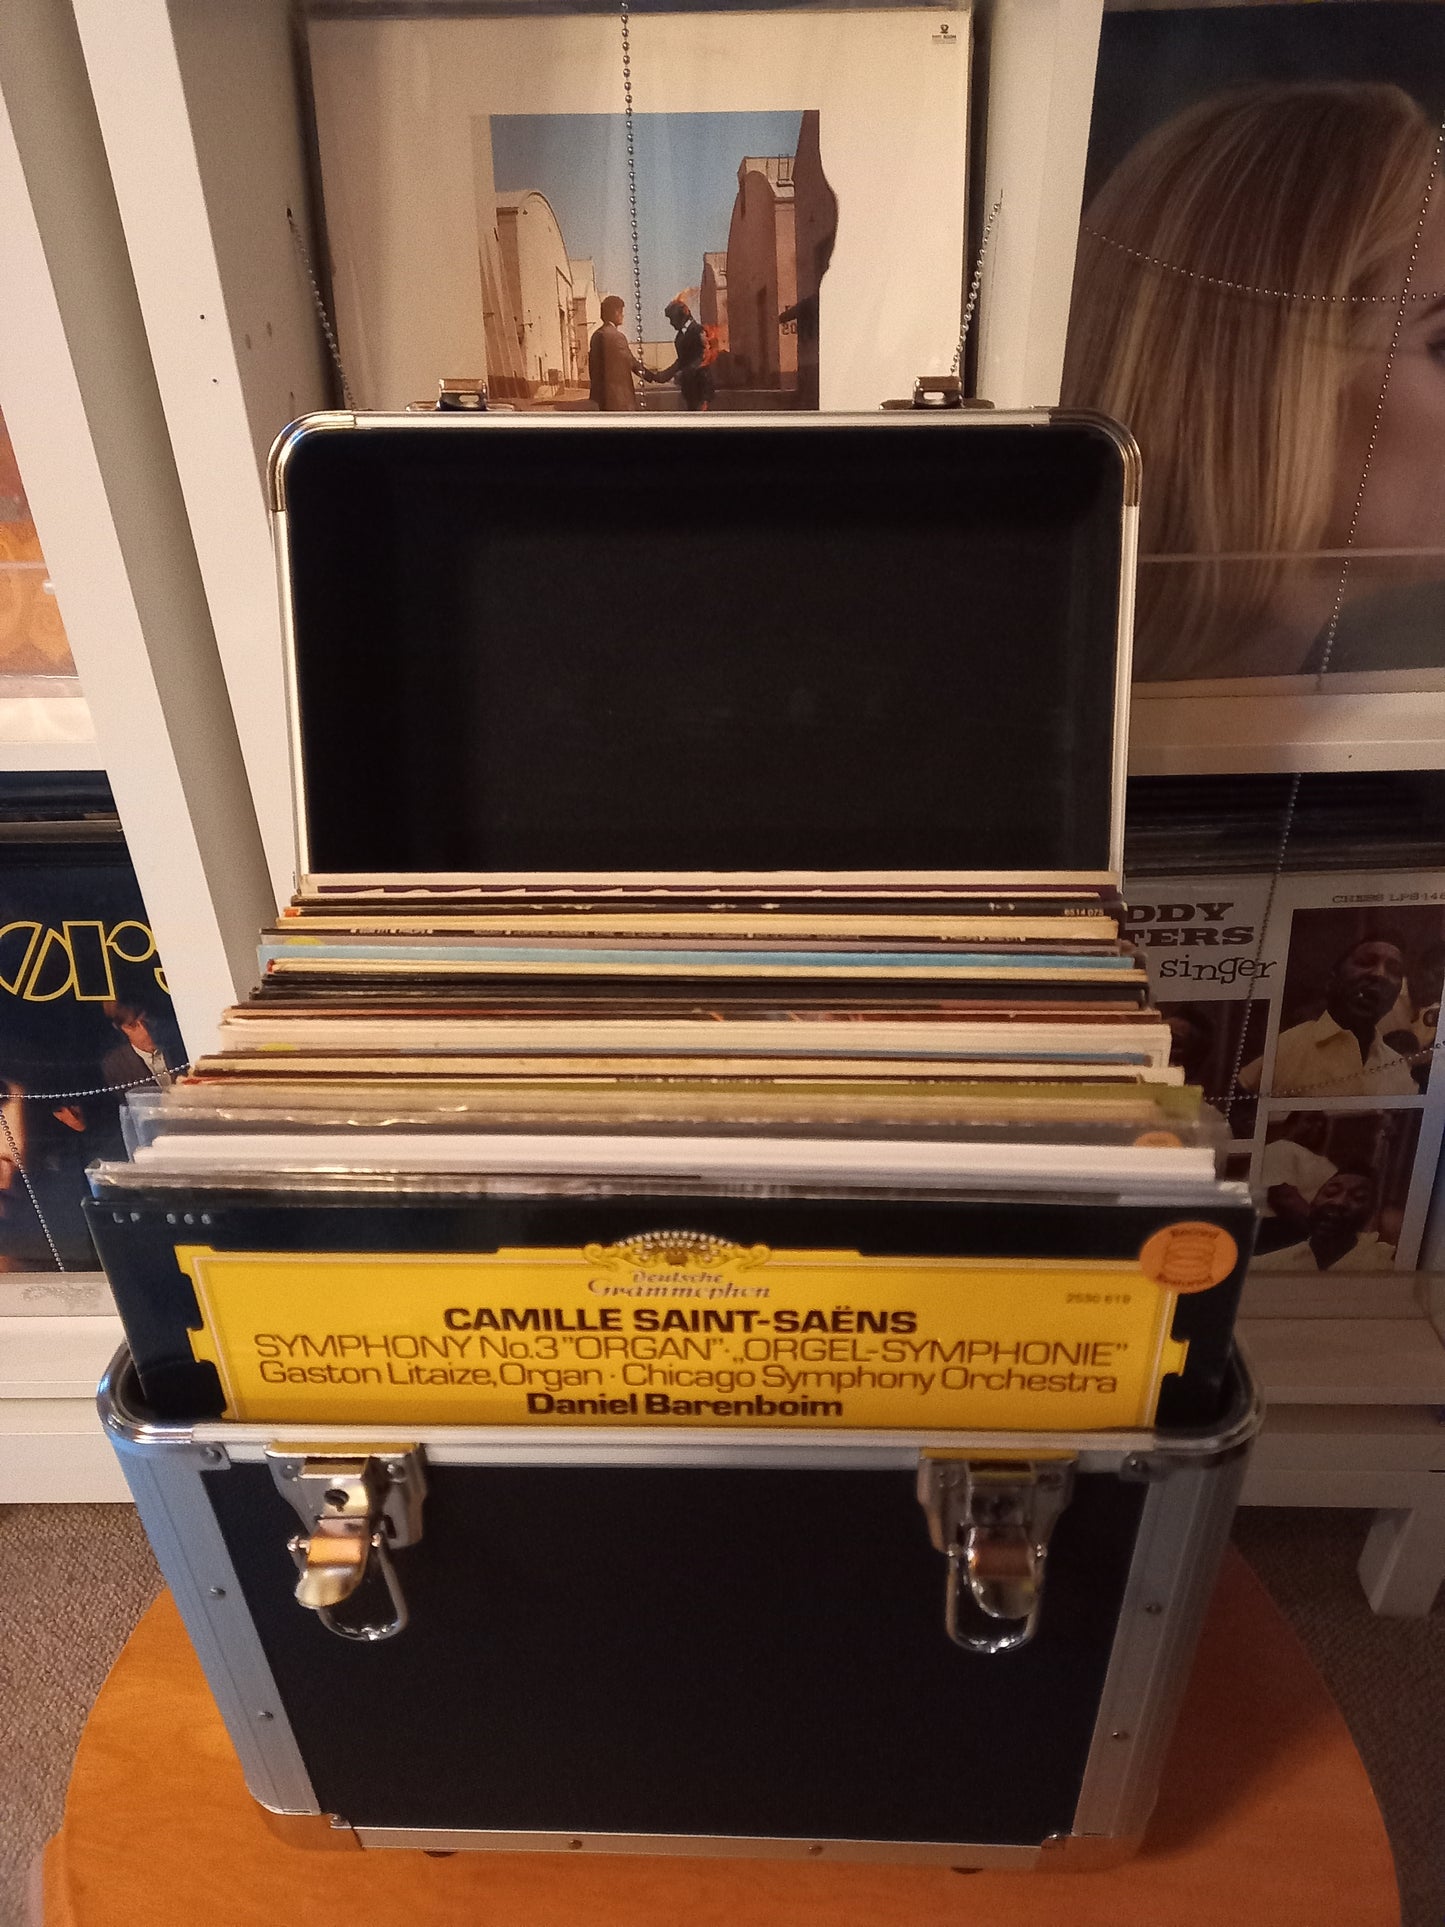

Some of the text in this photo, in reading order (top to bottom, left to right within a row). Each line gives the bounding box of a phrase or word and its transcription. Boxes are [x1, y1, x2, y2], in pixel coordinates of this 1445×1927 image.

[1159, 954, 1278, 985] singer
[633, 1270, 723, 1284] Deutsche
[444, 1305, 918, 1334] CAMILLE SAINT-SAËNS
[254, 1333, 472, 1359] SYMPHONY
[480, 1336, 560, 1360] No.3
[259, 1360, 1118, 1396] Gaston Litaize, Organ Chicago Symphony Orchestra
[526, 1392, 844, 1418] Daniel Barenboim
